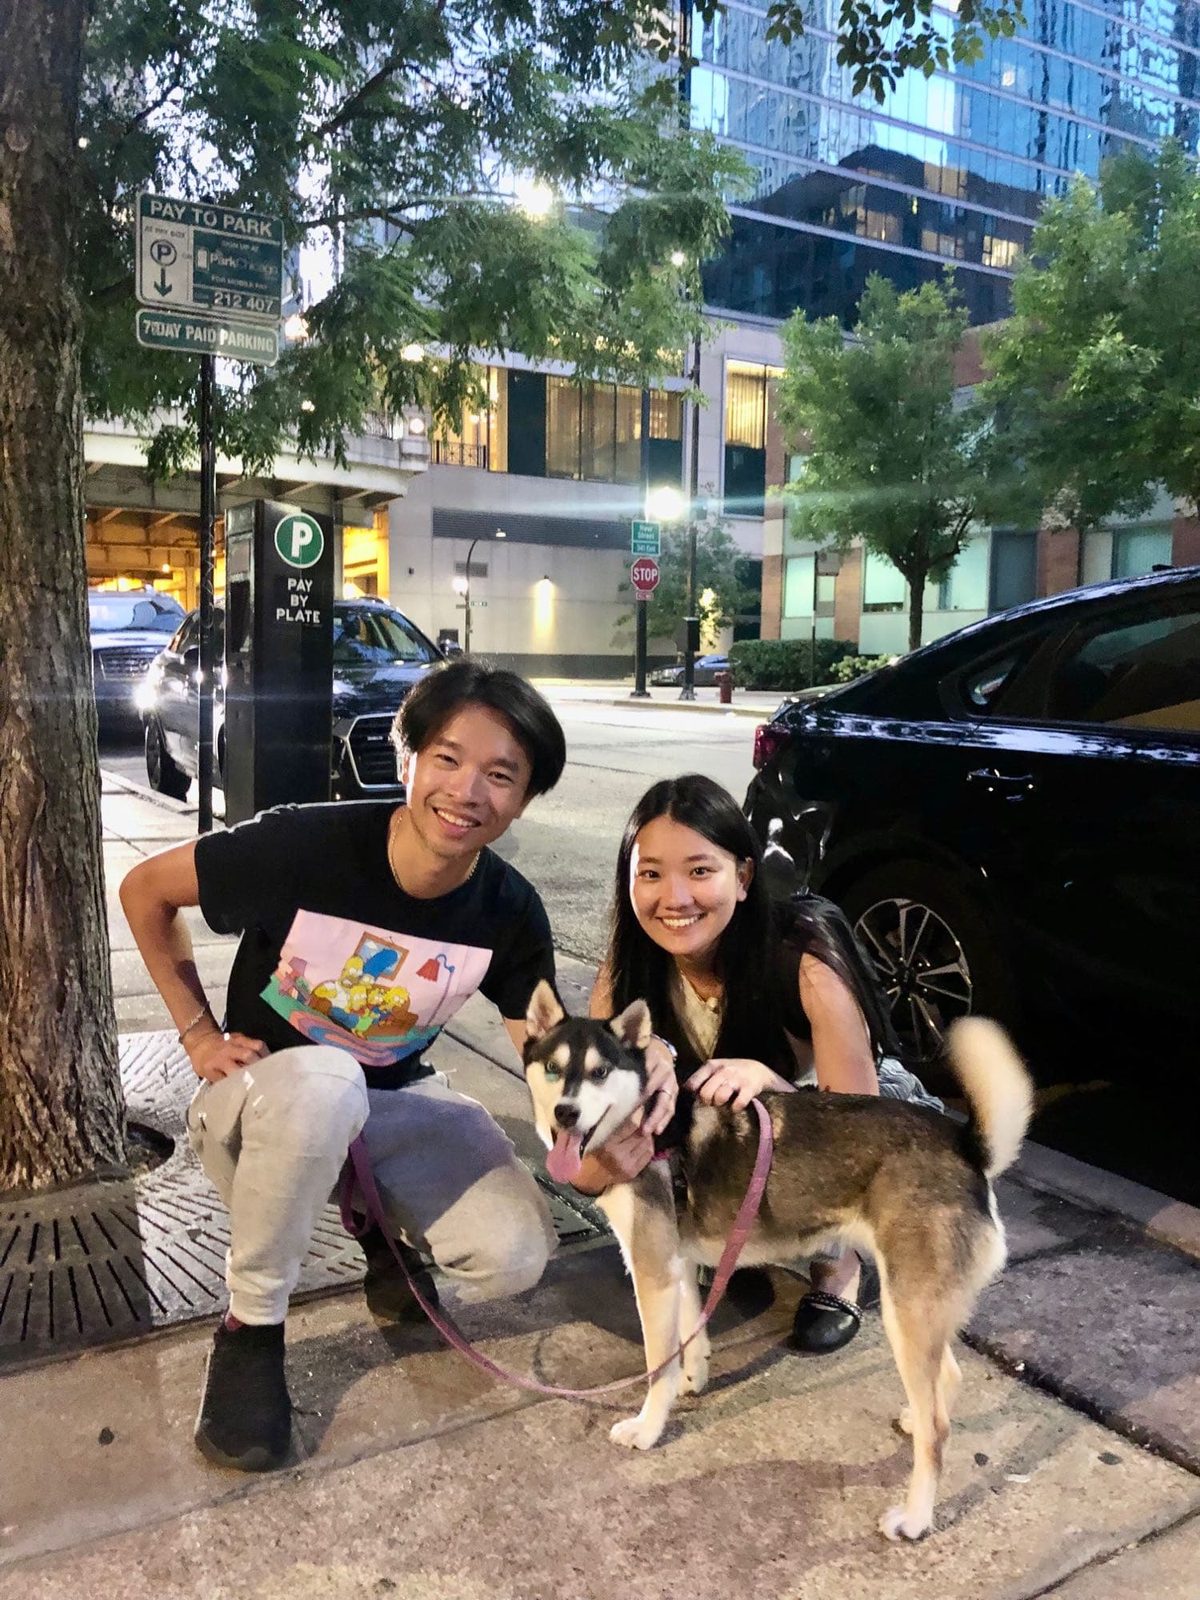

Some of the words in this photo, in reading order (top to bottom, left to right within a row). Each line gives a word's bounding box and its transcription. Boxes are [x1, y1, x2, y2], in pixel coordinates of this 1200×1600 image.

[150, 200, 186, 219] PAY
[191, 208, 217, 227] TO
[223, 214, 273, 238] PARK
[214, 291, 243, 308] 212
[246, 297, 274, 313] 407
[185, 325, 217, 344] PAID
[219, 327, 275, 353] PARKING
[291, 521, 313, 558] P
[633, 567, 658, 582] STOP
[287, 578, 313, 592] PAY
[290, 594, 309, 608] BY
[276, 608, 321, 624] PLATE
